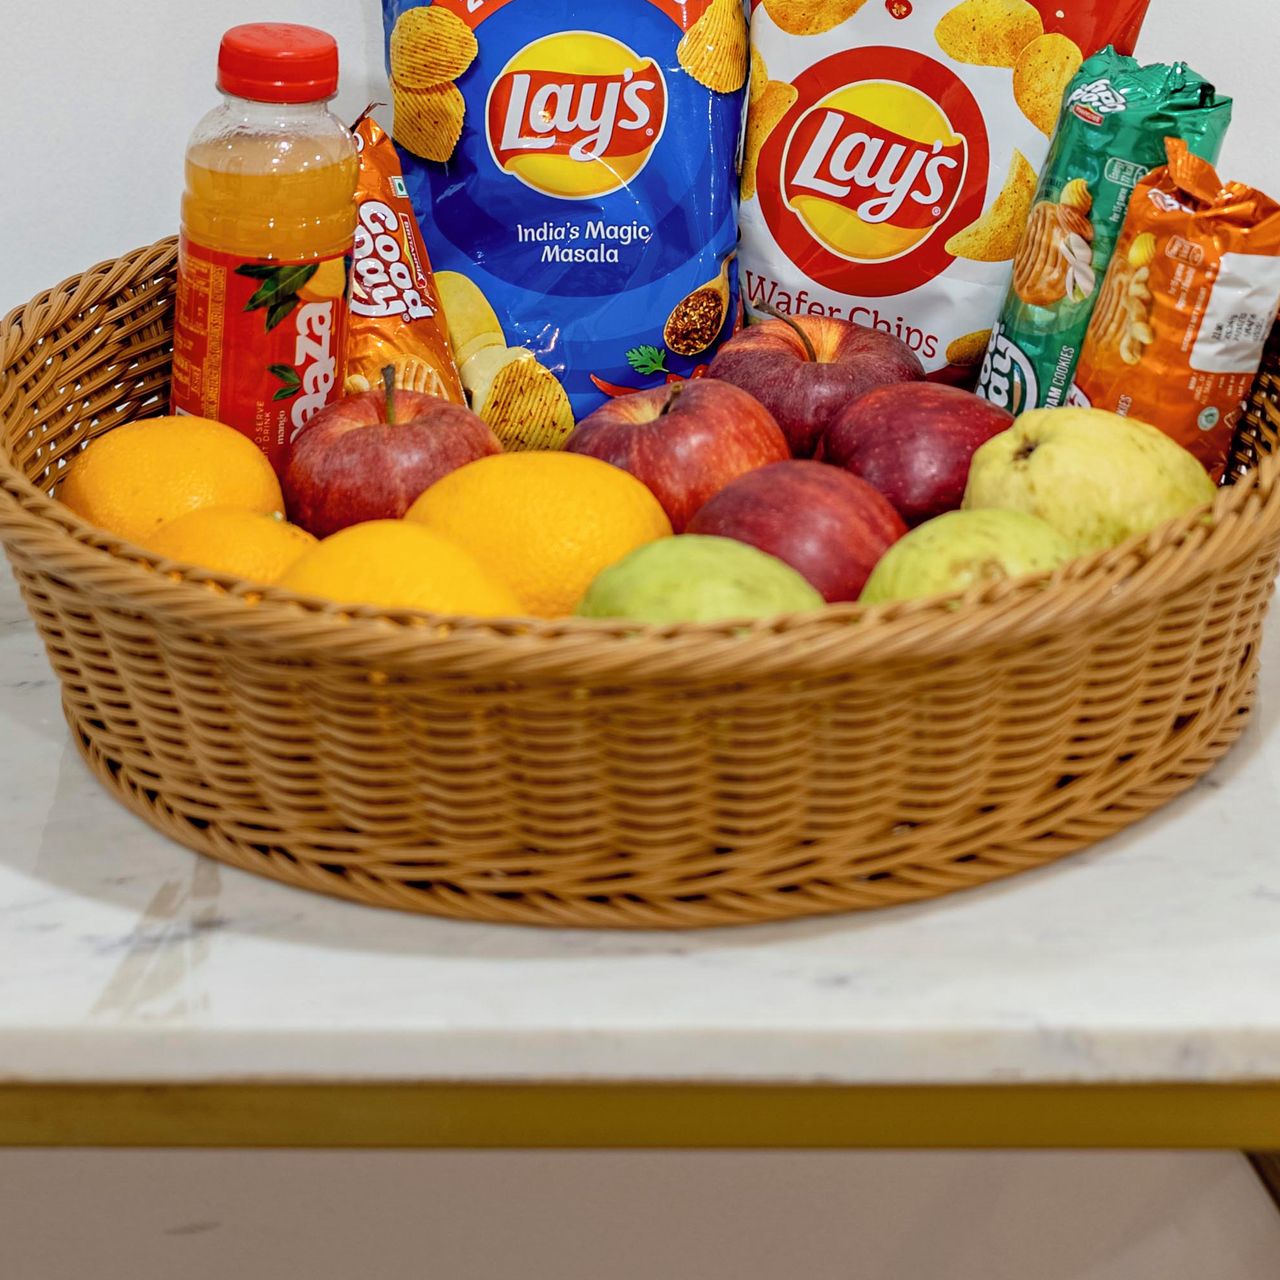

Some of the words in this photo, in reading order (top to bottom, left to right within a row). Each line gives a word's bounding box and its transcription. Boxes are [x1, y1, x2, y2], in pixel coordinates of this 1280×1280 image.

[500, 67, 656, 162] Lay's
[790, 110, 959, 224] Lay's
[350, 224, 408, 317] Day
[358, 200, 435, 319] Good
[403, 221, 425, 280] BRITANNIA
[516, 222, 580, 242] India's
[585, 220, 651, 245] Magic
[541, 244, 619, 263] Masala
[290, 301, 336, 444] aaza
[975, 321, 1000, 400] ood
[988, 334, 1038, 412] ay
[1052, 345, 1075, 387] COOKIES
[277, 410, 288, 445] mango
[1116, 394, 1133, 417] KIES
